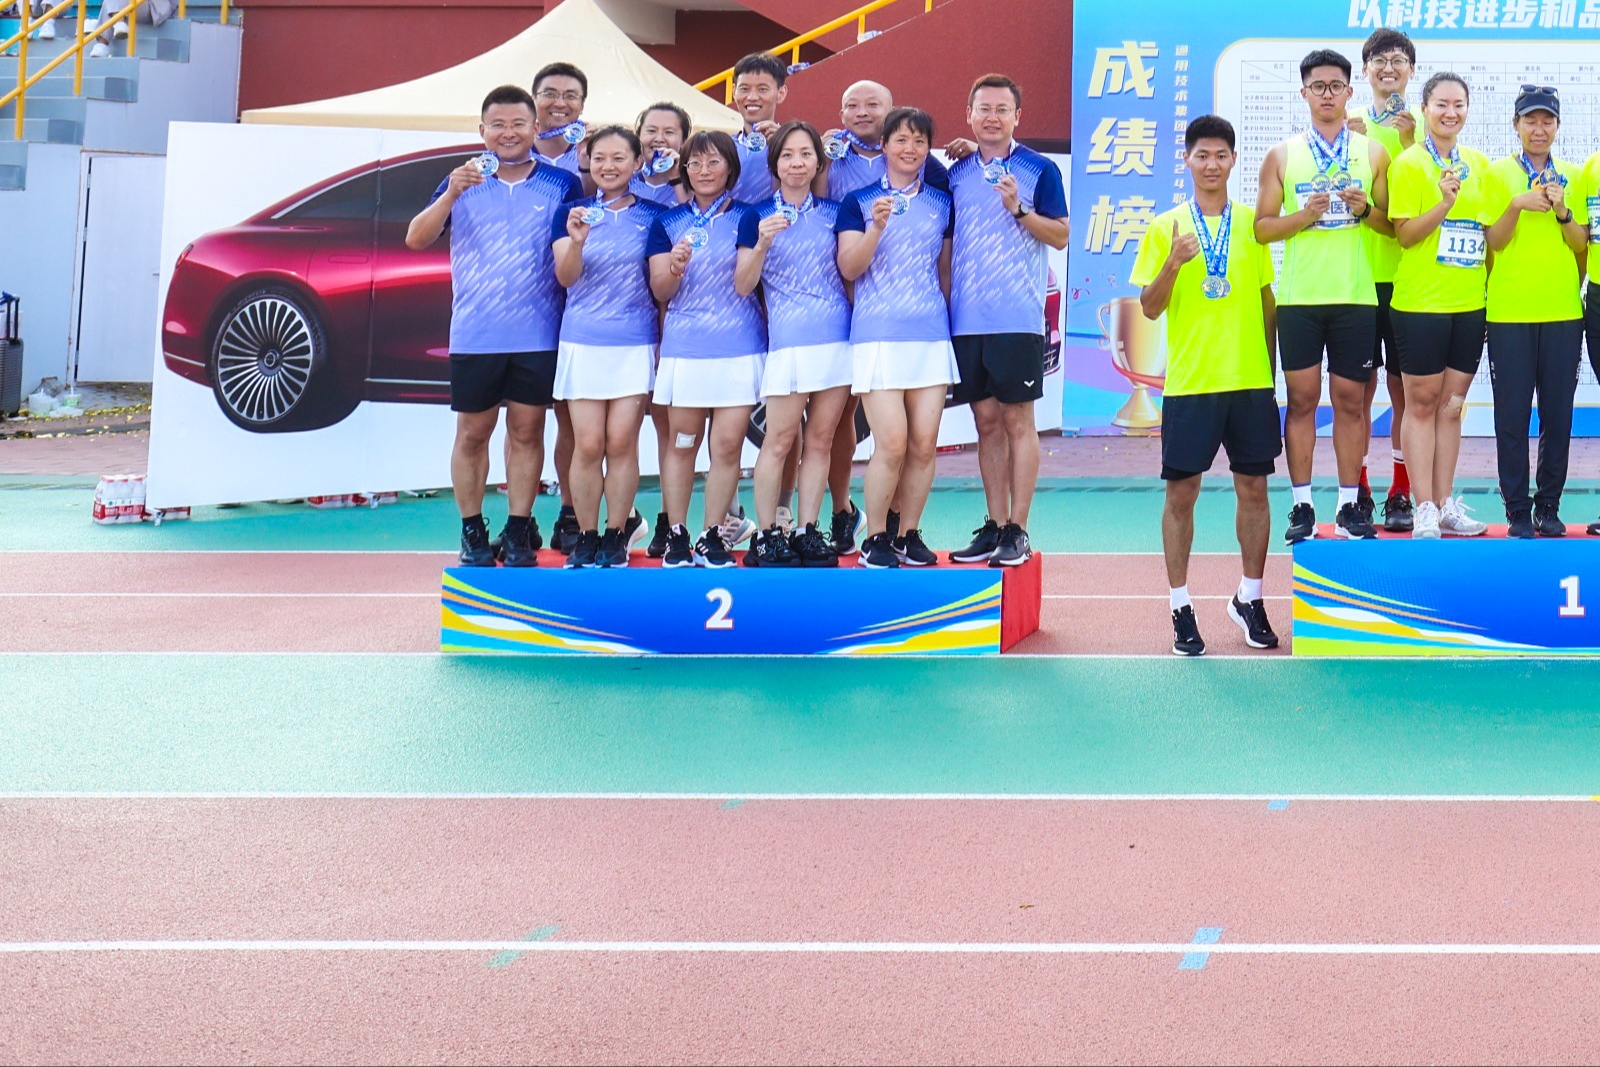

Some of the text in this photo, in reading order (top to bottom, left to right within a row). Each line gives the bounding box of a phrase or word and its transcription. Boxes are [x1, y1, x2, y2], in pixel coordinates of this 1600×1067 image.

[1447, 237, 1486, 256] 1134
[704, 586, 734, 629] 2
[1558, 574, 1586, 617] 1
